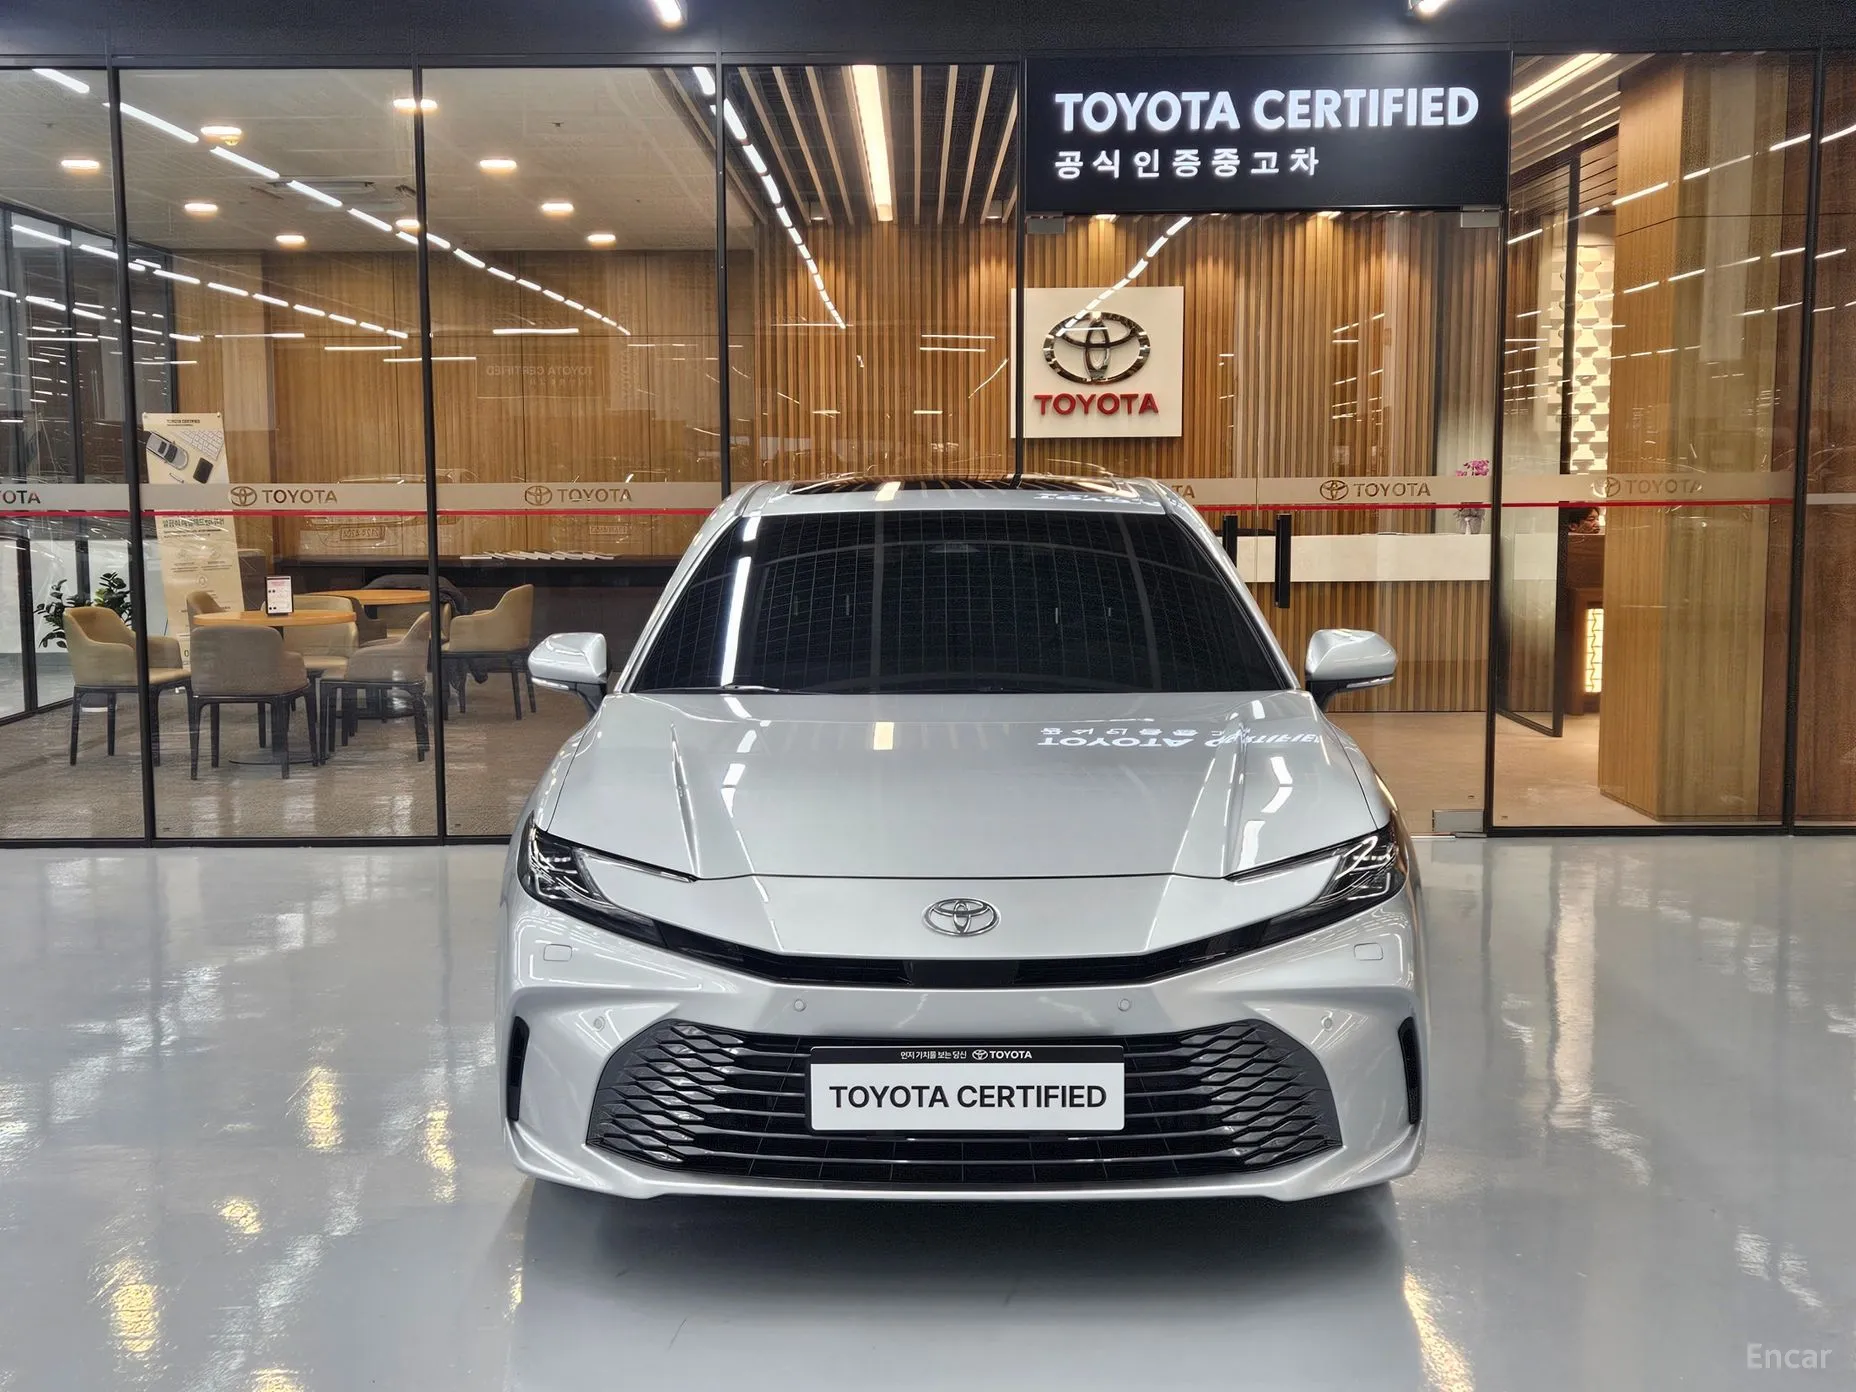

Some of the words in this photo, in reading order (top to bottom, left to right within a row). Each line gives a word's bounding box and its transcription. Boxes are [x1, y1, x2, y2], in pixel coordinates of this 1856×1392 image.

[1055, 90, 1240, 132] TOYOTA
[1253, 87, 1479, 129] CERTIFIED
[1034, 393, 1159, 415] TOYOTA
[1353, 483, 1431, 497] TOYOTA
[1624, 479, 1704, 494] TOYOTA
[0, 490, 41, 504] OTA
[261, 489, 338, 503] TOYOTA
[557, 488, 632, 502] TOYOTA
[989, 1050, 1033, 1059] TOYOTA
[829, 1085, 949, 1108] TOYOTA
[957, 1085, 1107, 1108] CERTIFIED
